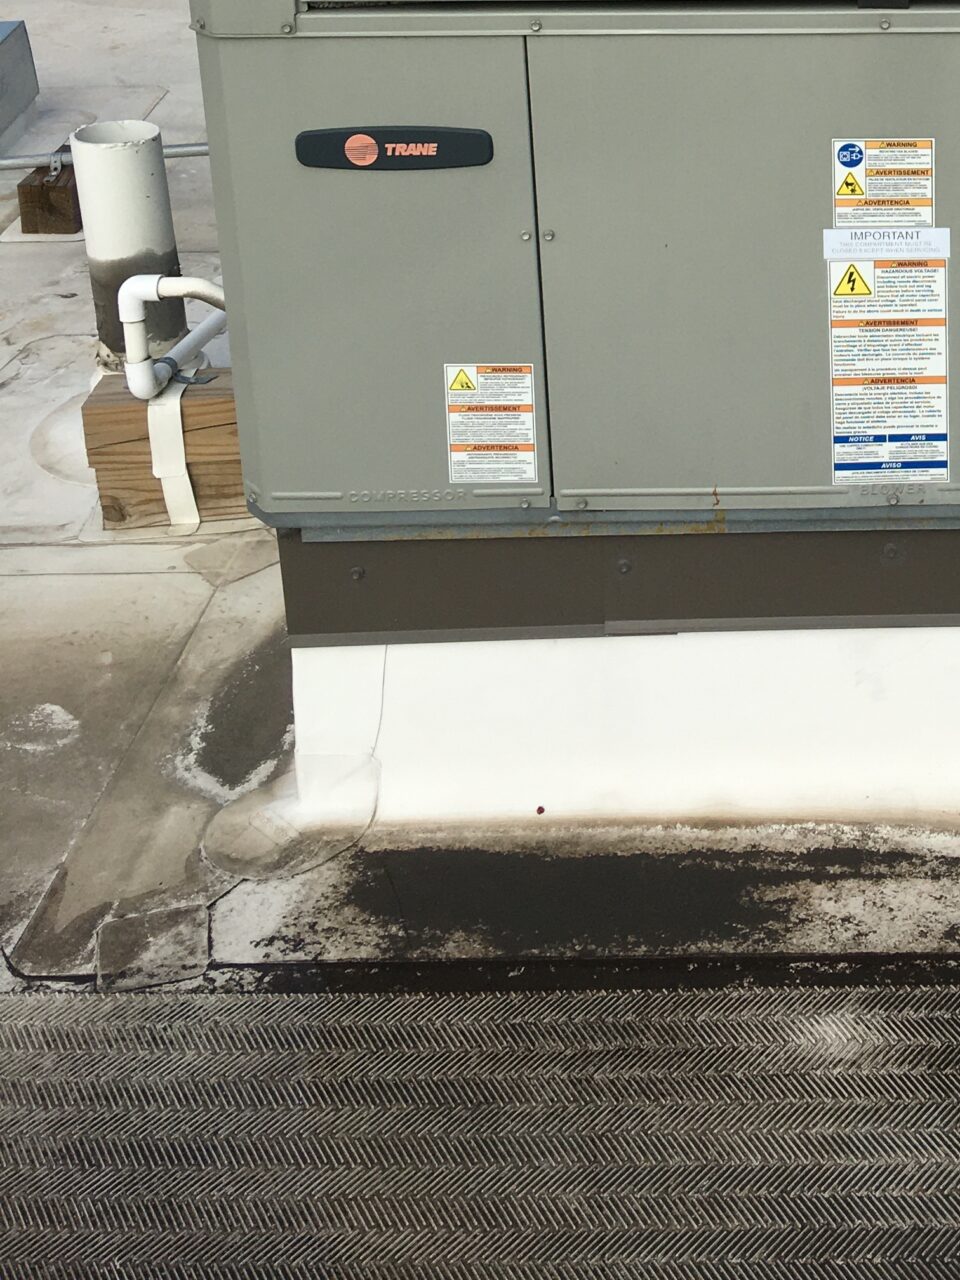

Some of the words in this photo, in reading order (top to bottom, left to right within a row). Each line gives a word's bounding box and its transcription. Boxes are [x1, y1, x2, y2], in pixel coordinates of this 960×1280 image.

[385, 143, 438, 156] TRANE
[851, 231, 921, 240] IMPORTANT
[861, 485, 926, 495] BLOWER
[349, 489, 467, 503] COMPRESSOR
